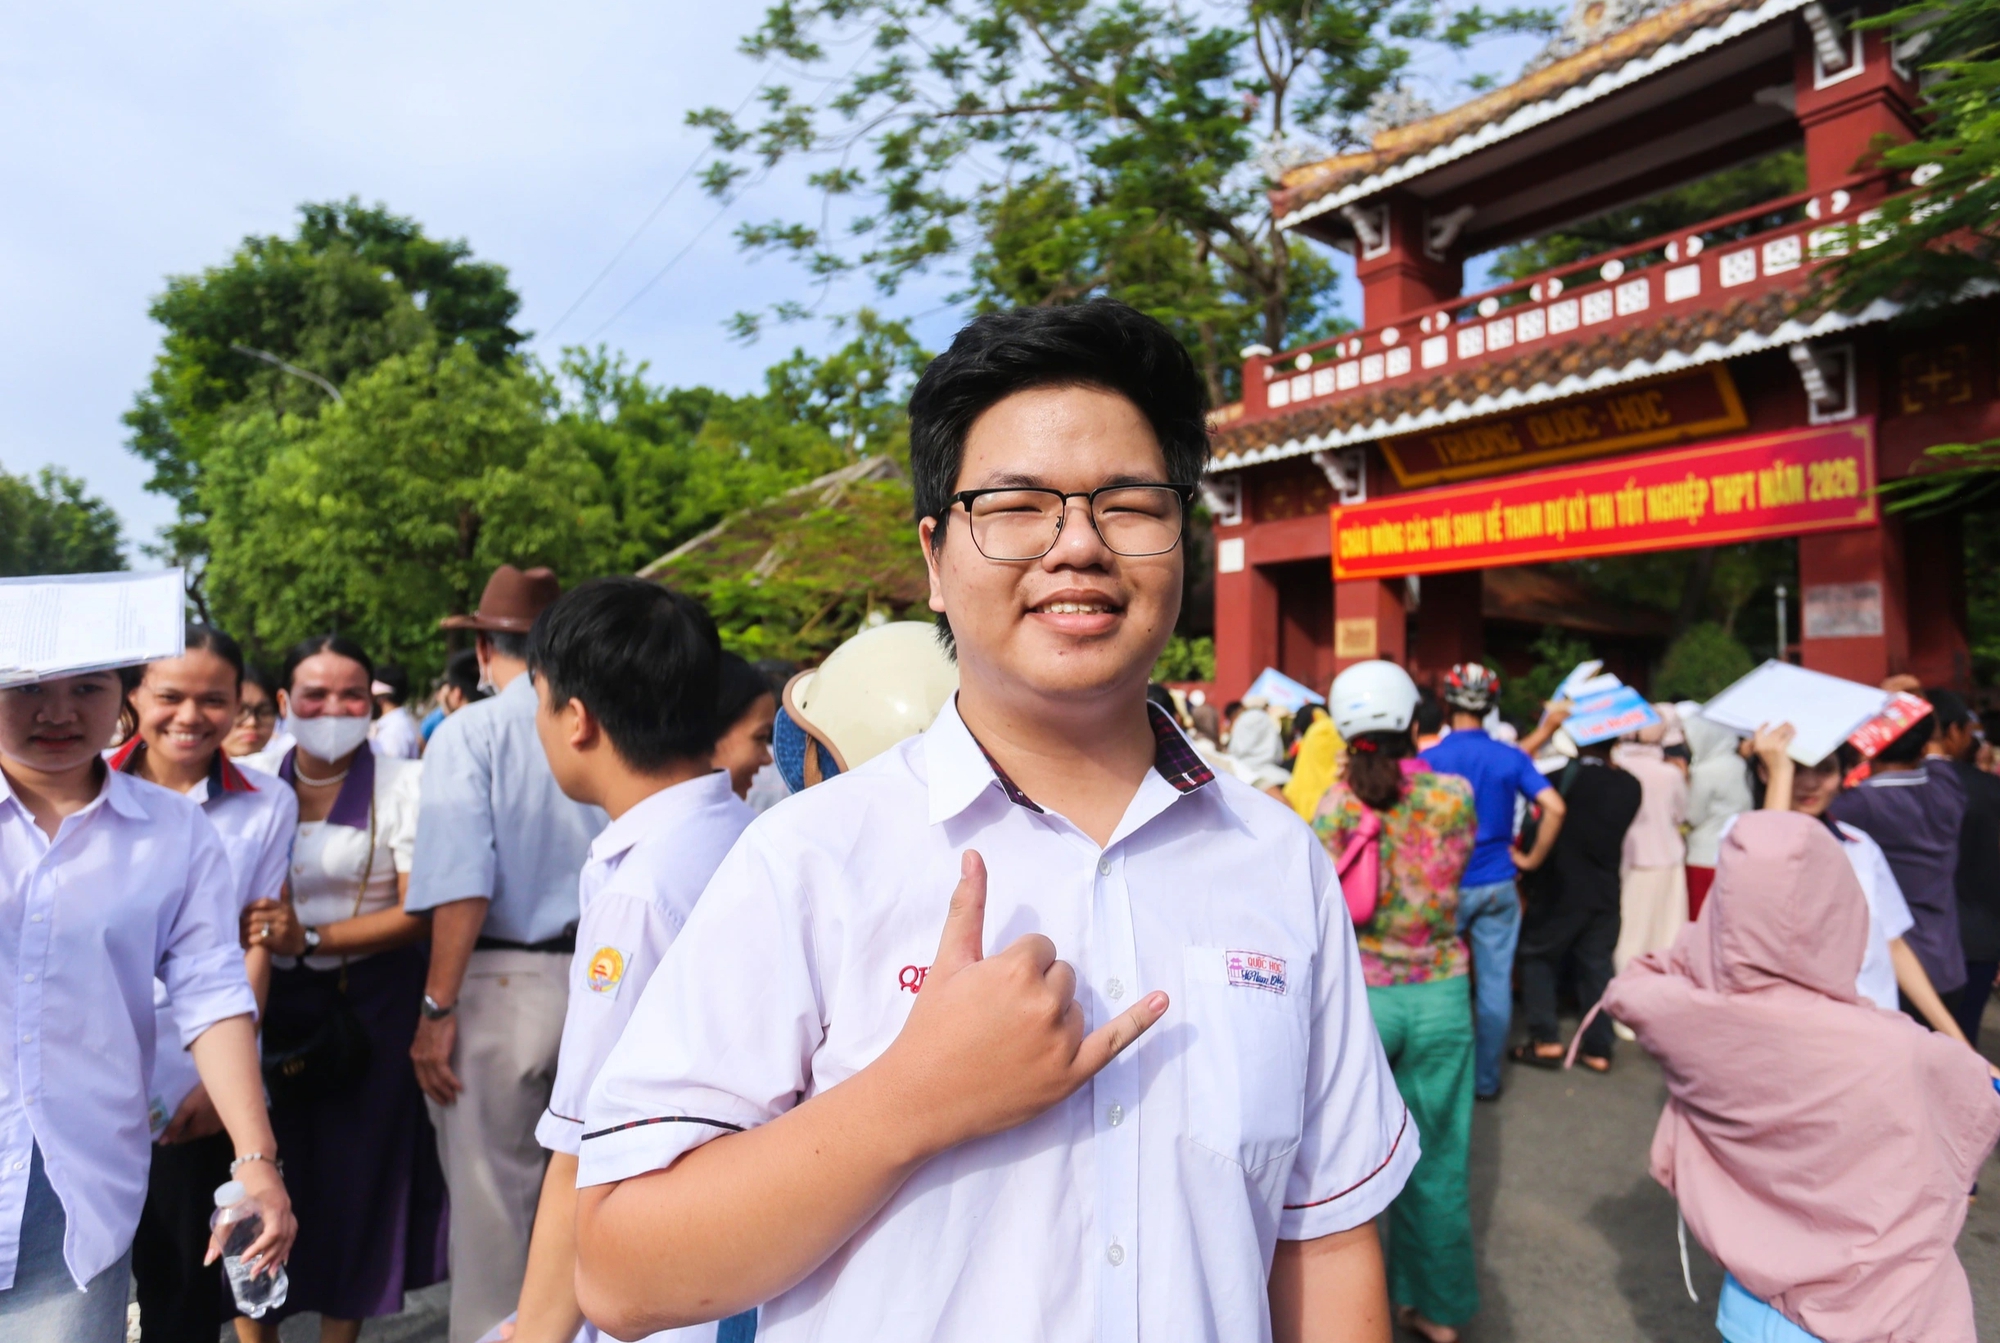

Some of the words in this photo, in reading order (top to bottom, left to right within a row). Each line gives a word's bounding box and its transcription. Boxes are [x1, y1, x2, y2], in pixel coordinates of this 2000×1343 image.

[1405, 512, 1430, 553] CÁC
[1430, 507, 1453, 550] THÍ
[1453, 510, 1485, 548] SINH
[1503, 501, 1543, 541] THAM
[1588, 490, 1616, 531] THI
[1615, 475, 1645, 527] TỐT
[1646, 471, 1710, 527] NGHIỆP
[1710, 469, 1756, 516] THPT
[1758, 458, 1806, 509] NĂM
[1248, 957, 1267, 969] QUỐC
